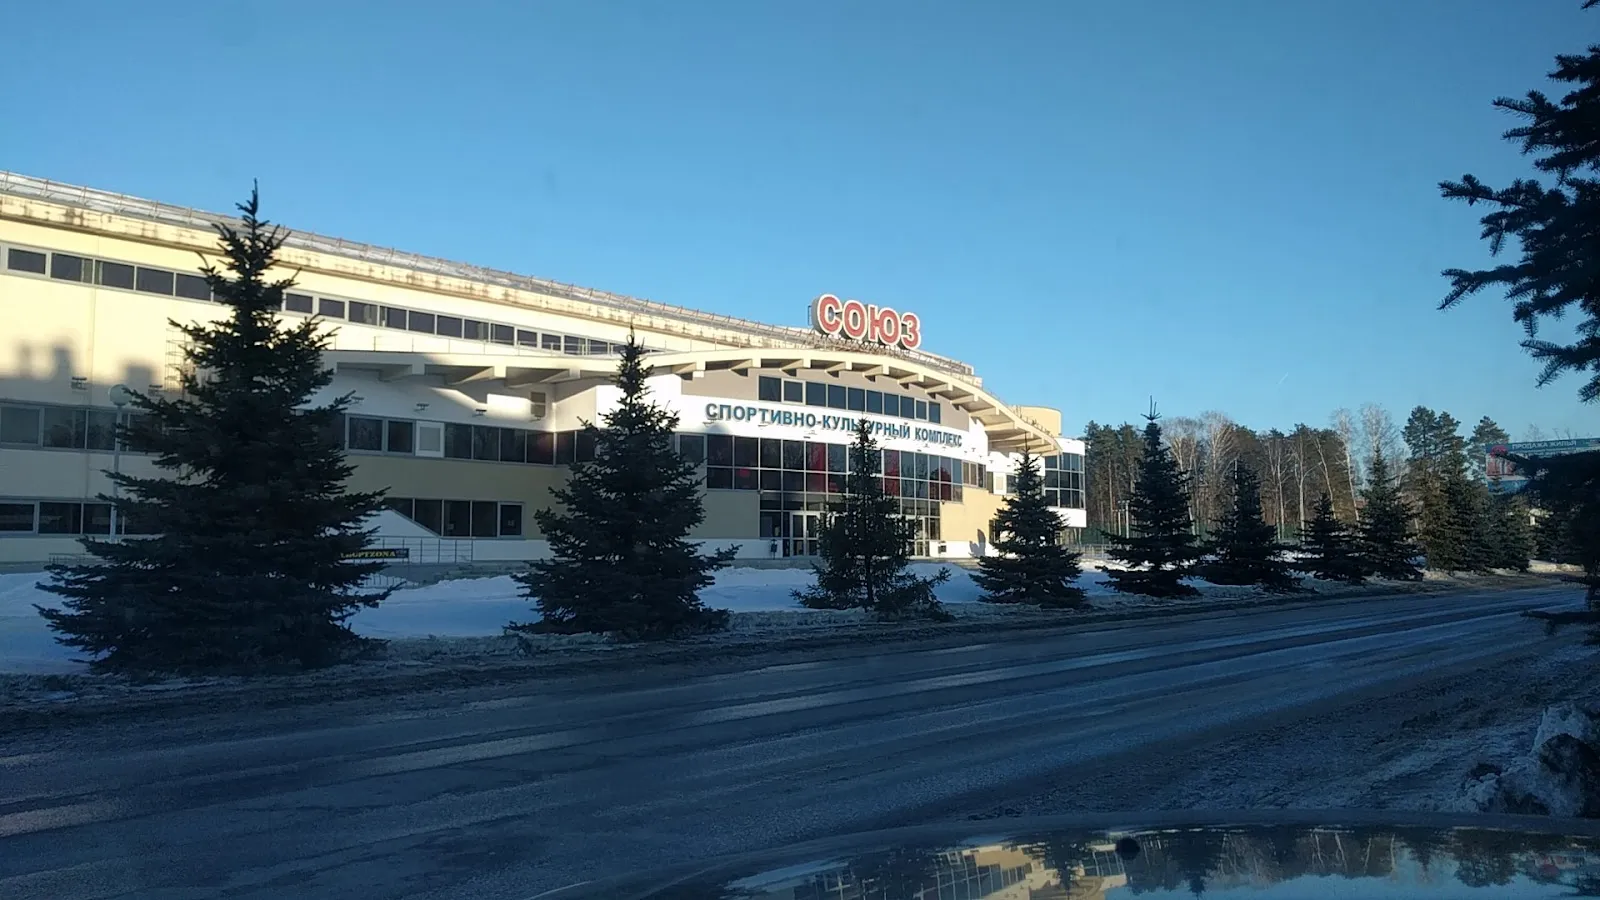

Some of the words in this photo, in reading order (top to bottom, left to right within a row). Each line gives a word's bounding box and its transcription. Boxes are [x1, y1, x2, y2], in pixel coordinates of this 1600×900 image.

[816, 293, 922, 349] СОЮЗ
[705, 403, 911, 438] СПОРТИВНО-КУЛЬУРНЫЙ
[914, 427, 962, 448] КОМПЛЕКС
[1511, 442, 1548, 450] ПРОДАЖА
